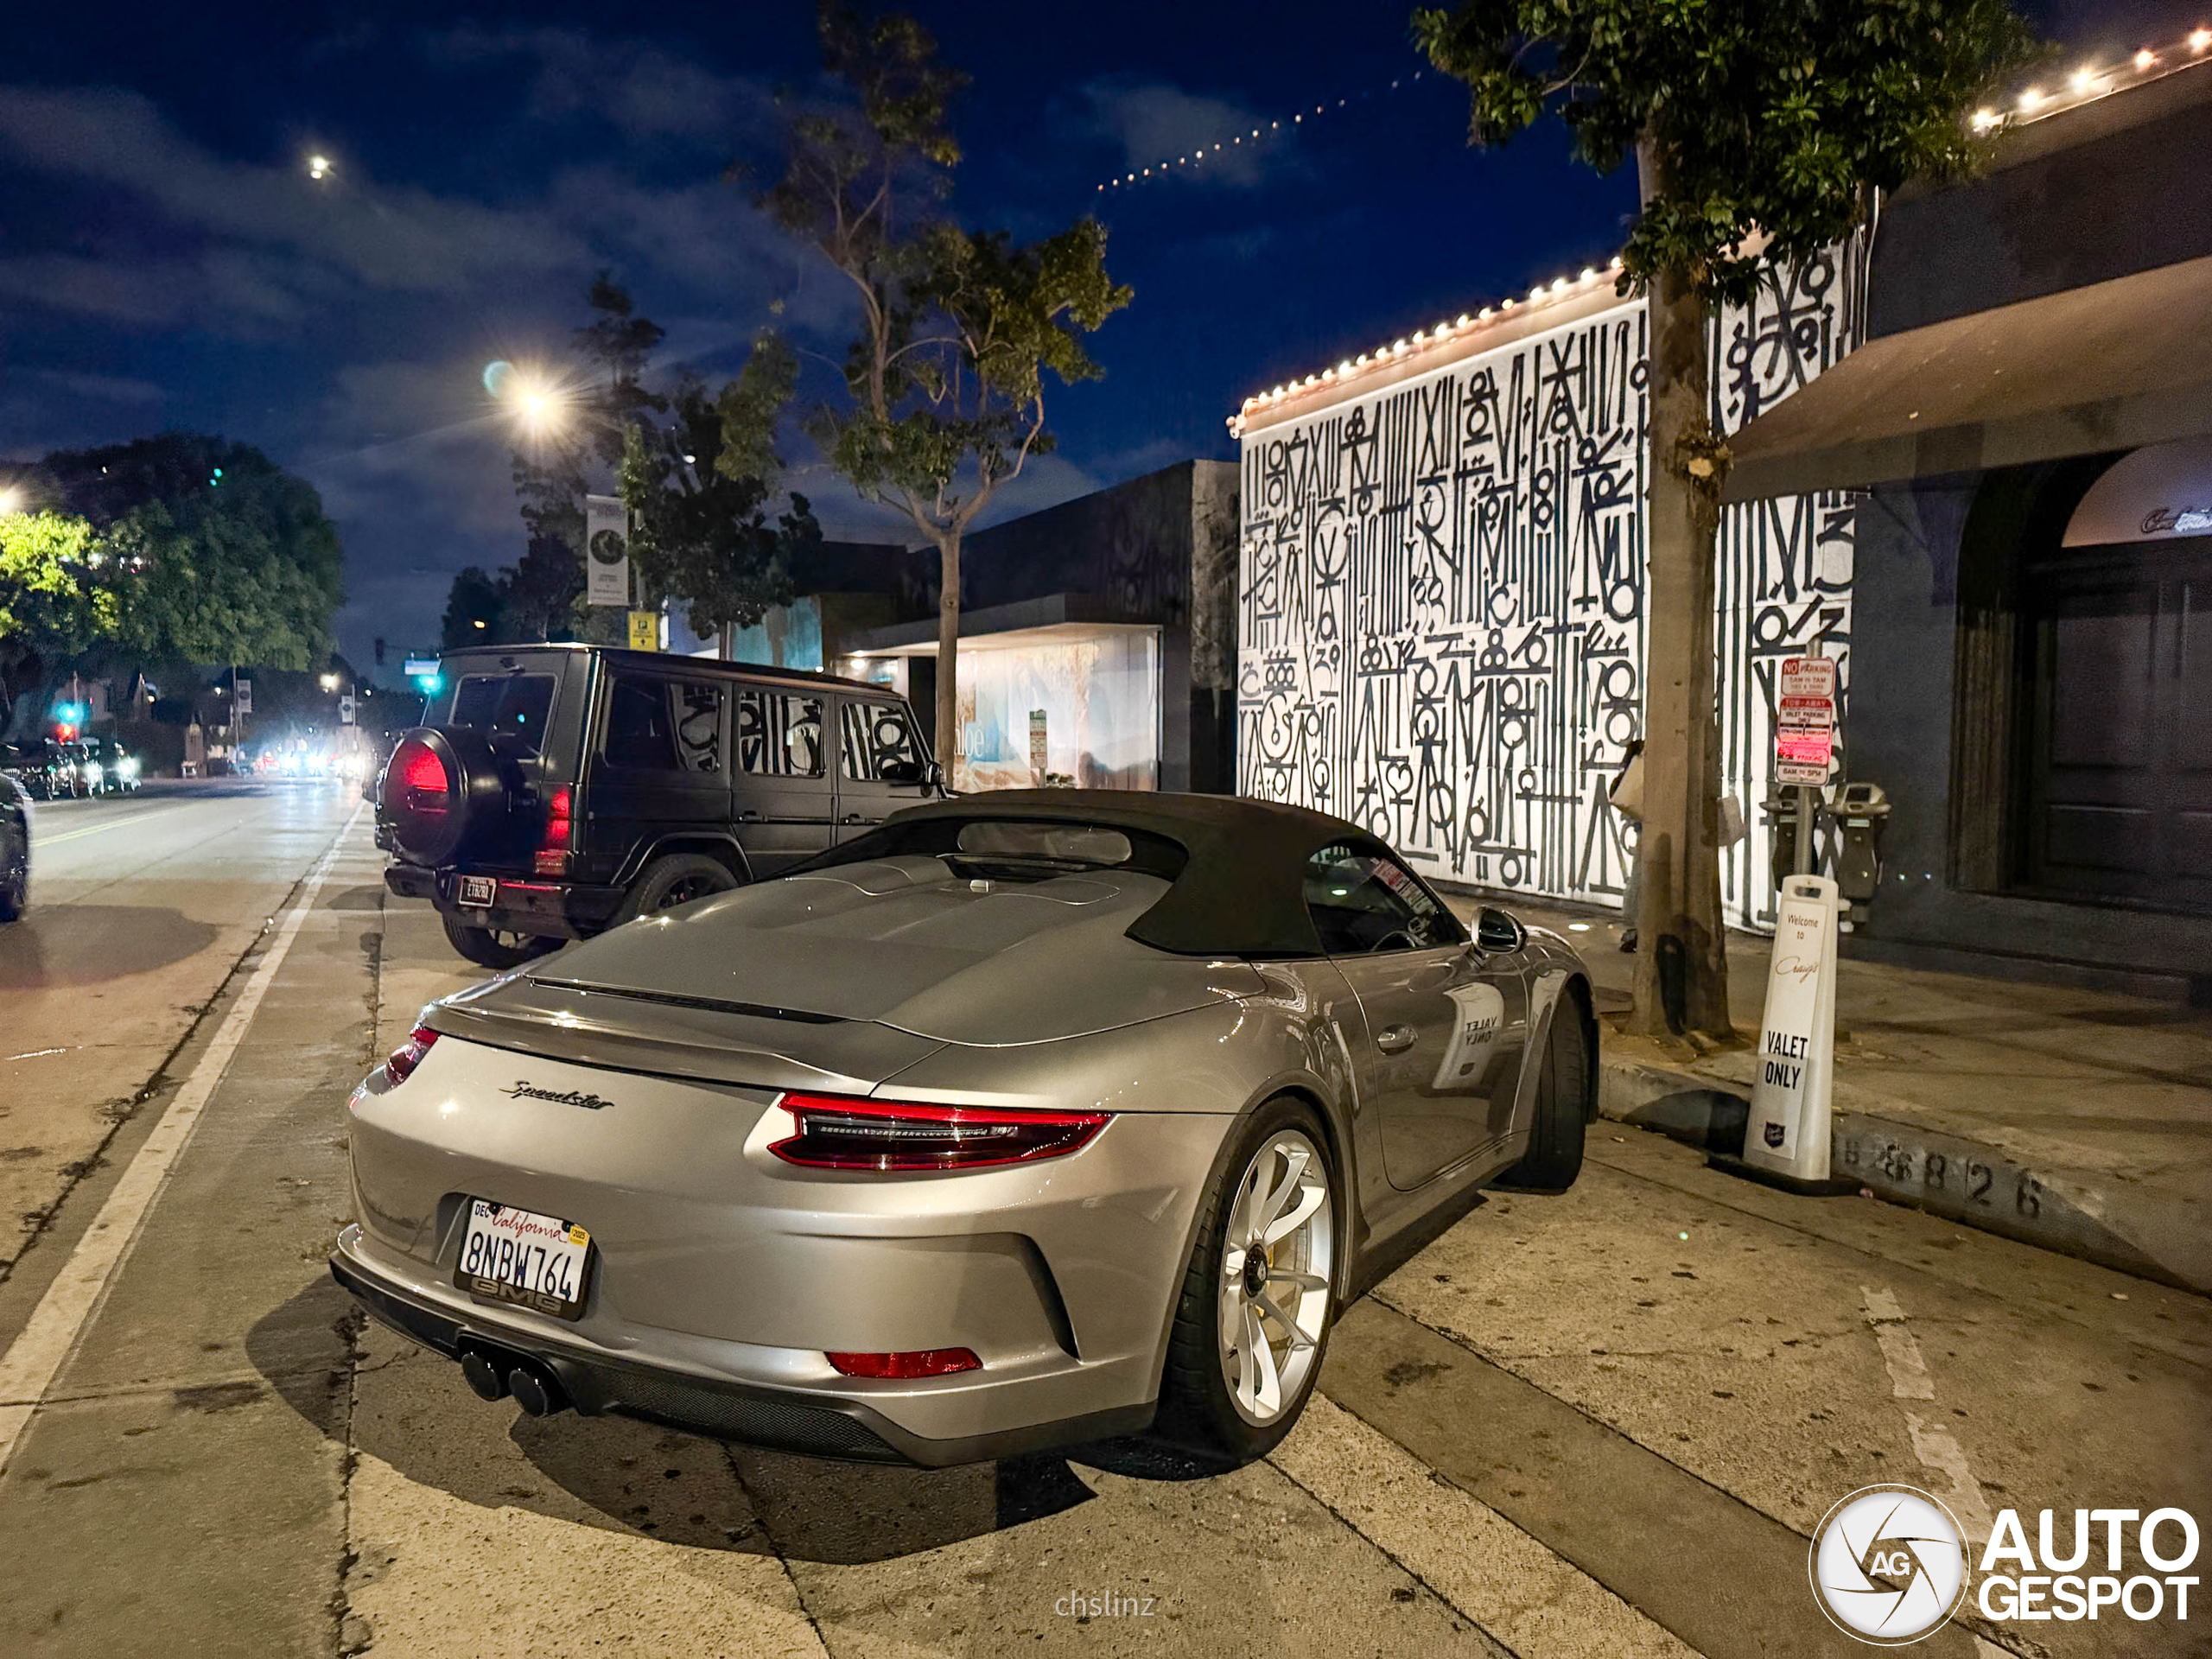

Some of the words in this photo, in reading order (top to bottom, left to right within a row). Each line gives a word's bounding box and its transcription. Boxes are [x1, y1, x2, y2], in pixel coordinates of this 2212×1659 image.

[1784, 662, 1798, 673] NO
[1801, 664, 1832, 673] PARKING
[954, 717, 985, 757] hloé
[1788, 913, 1819, 928] Welcome
[1796, 931, 1804, 939] to
[1775, 956, 1819, 983] Craig's
[1767, 1030, 1808, 1060] VALET
[1764, 1061, 1801, 1090] ONLY
[499, 1080, 615, 1110] Speedster
[474, 1204, 490, 1218] DEC
[491, 1205, 568, 1243] California
[573, 1229, 587, 1240] 2025
[467, 1231, 572, 1301] 8NBW764
